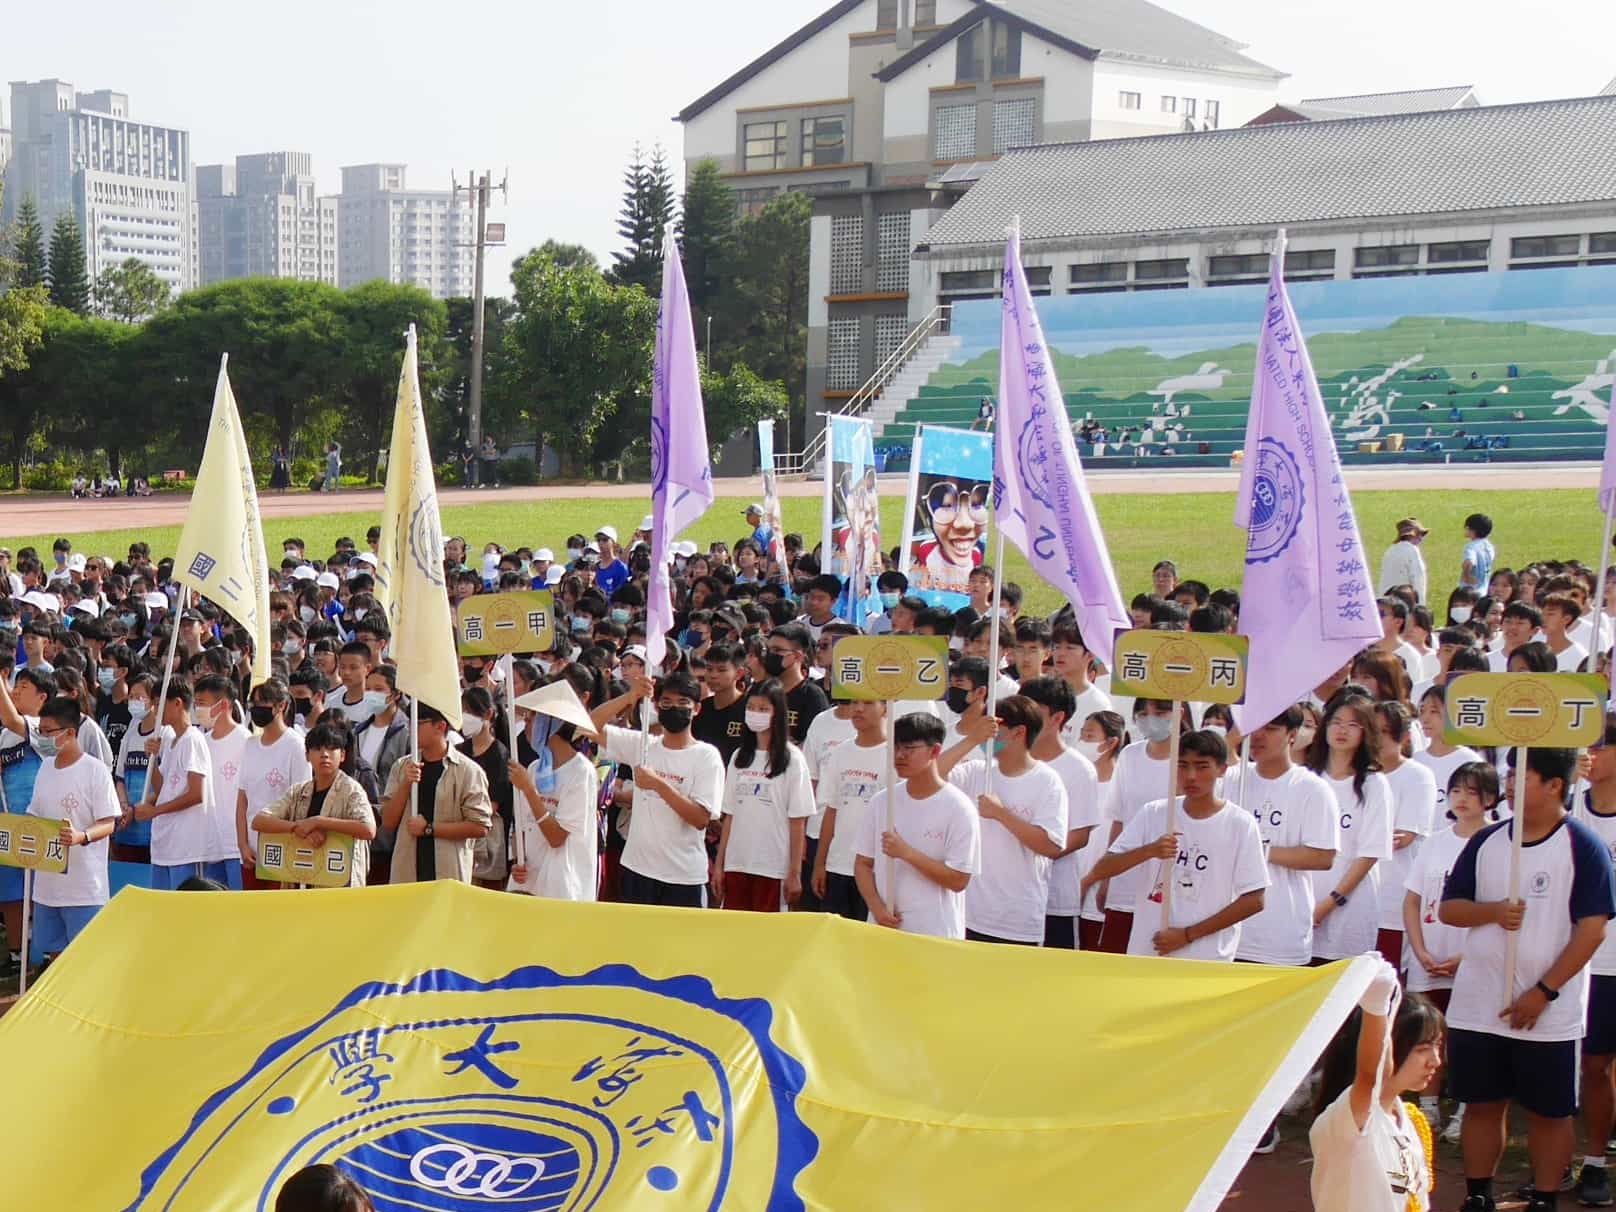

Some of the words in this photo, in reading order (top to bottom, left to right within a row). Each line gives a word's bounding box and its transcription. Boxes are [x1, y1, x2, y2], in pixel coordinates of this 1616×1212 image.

[462, 611, 547, 642] 高一甲
[839, 657, 941, 684] 高一乙
[1121, 651, 1239, 688] 高一丙
[1455, 697, 1596, 728] 高一丁
[263, 844, 346, 874] 國二己
